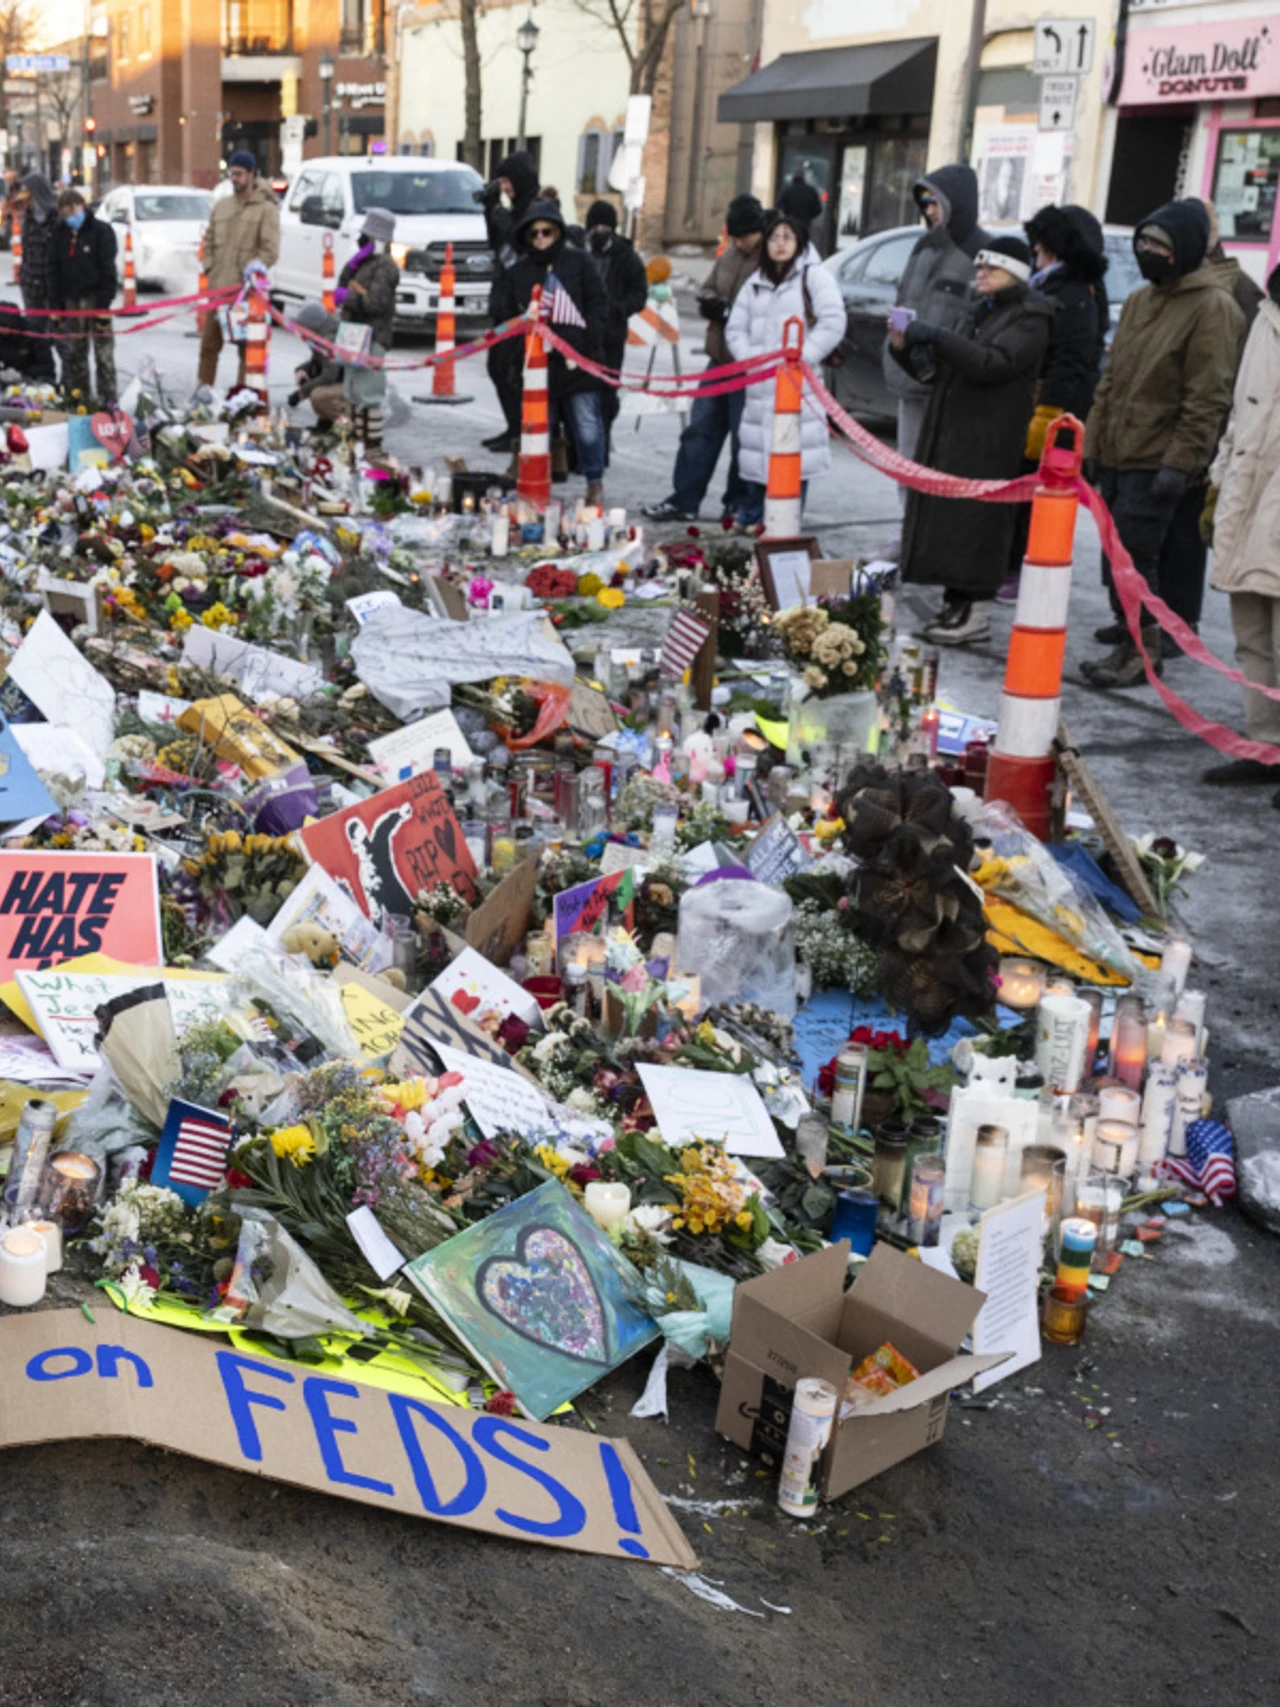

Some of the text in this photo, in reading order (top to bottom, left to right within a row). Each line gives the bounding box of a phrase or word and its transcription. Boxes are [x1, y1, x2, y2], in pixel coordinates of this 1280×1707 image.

[1152, 36, 1261, 78] Glam Doll
[1158, 75, 1248, 96] DONUTS
[97, 420, 128, 437] LOVE
[405, 839, 440, 889] RIP
[7, 915, 111, 960] HAS
[26, 1344, 154, 1388] on
[216, 1351, 650, 1559] FEDS!
